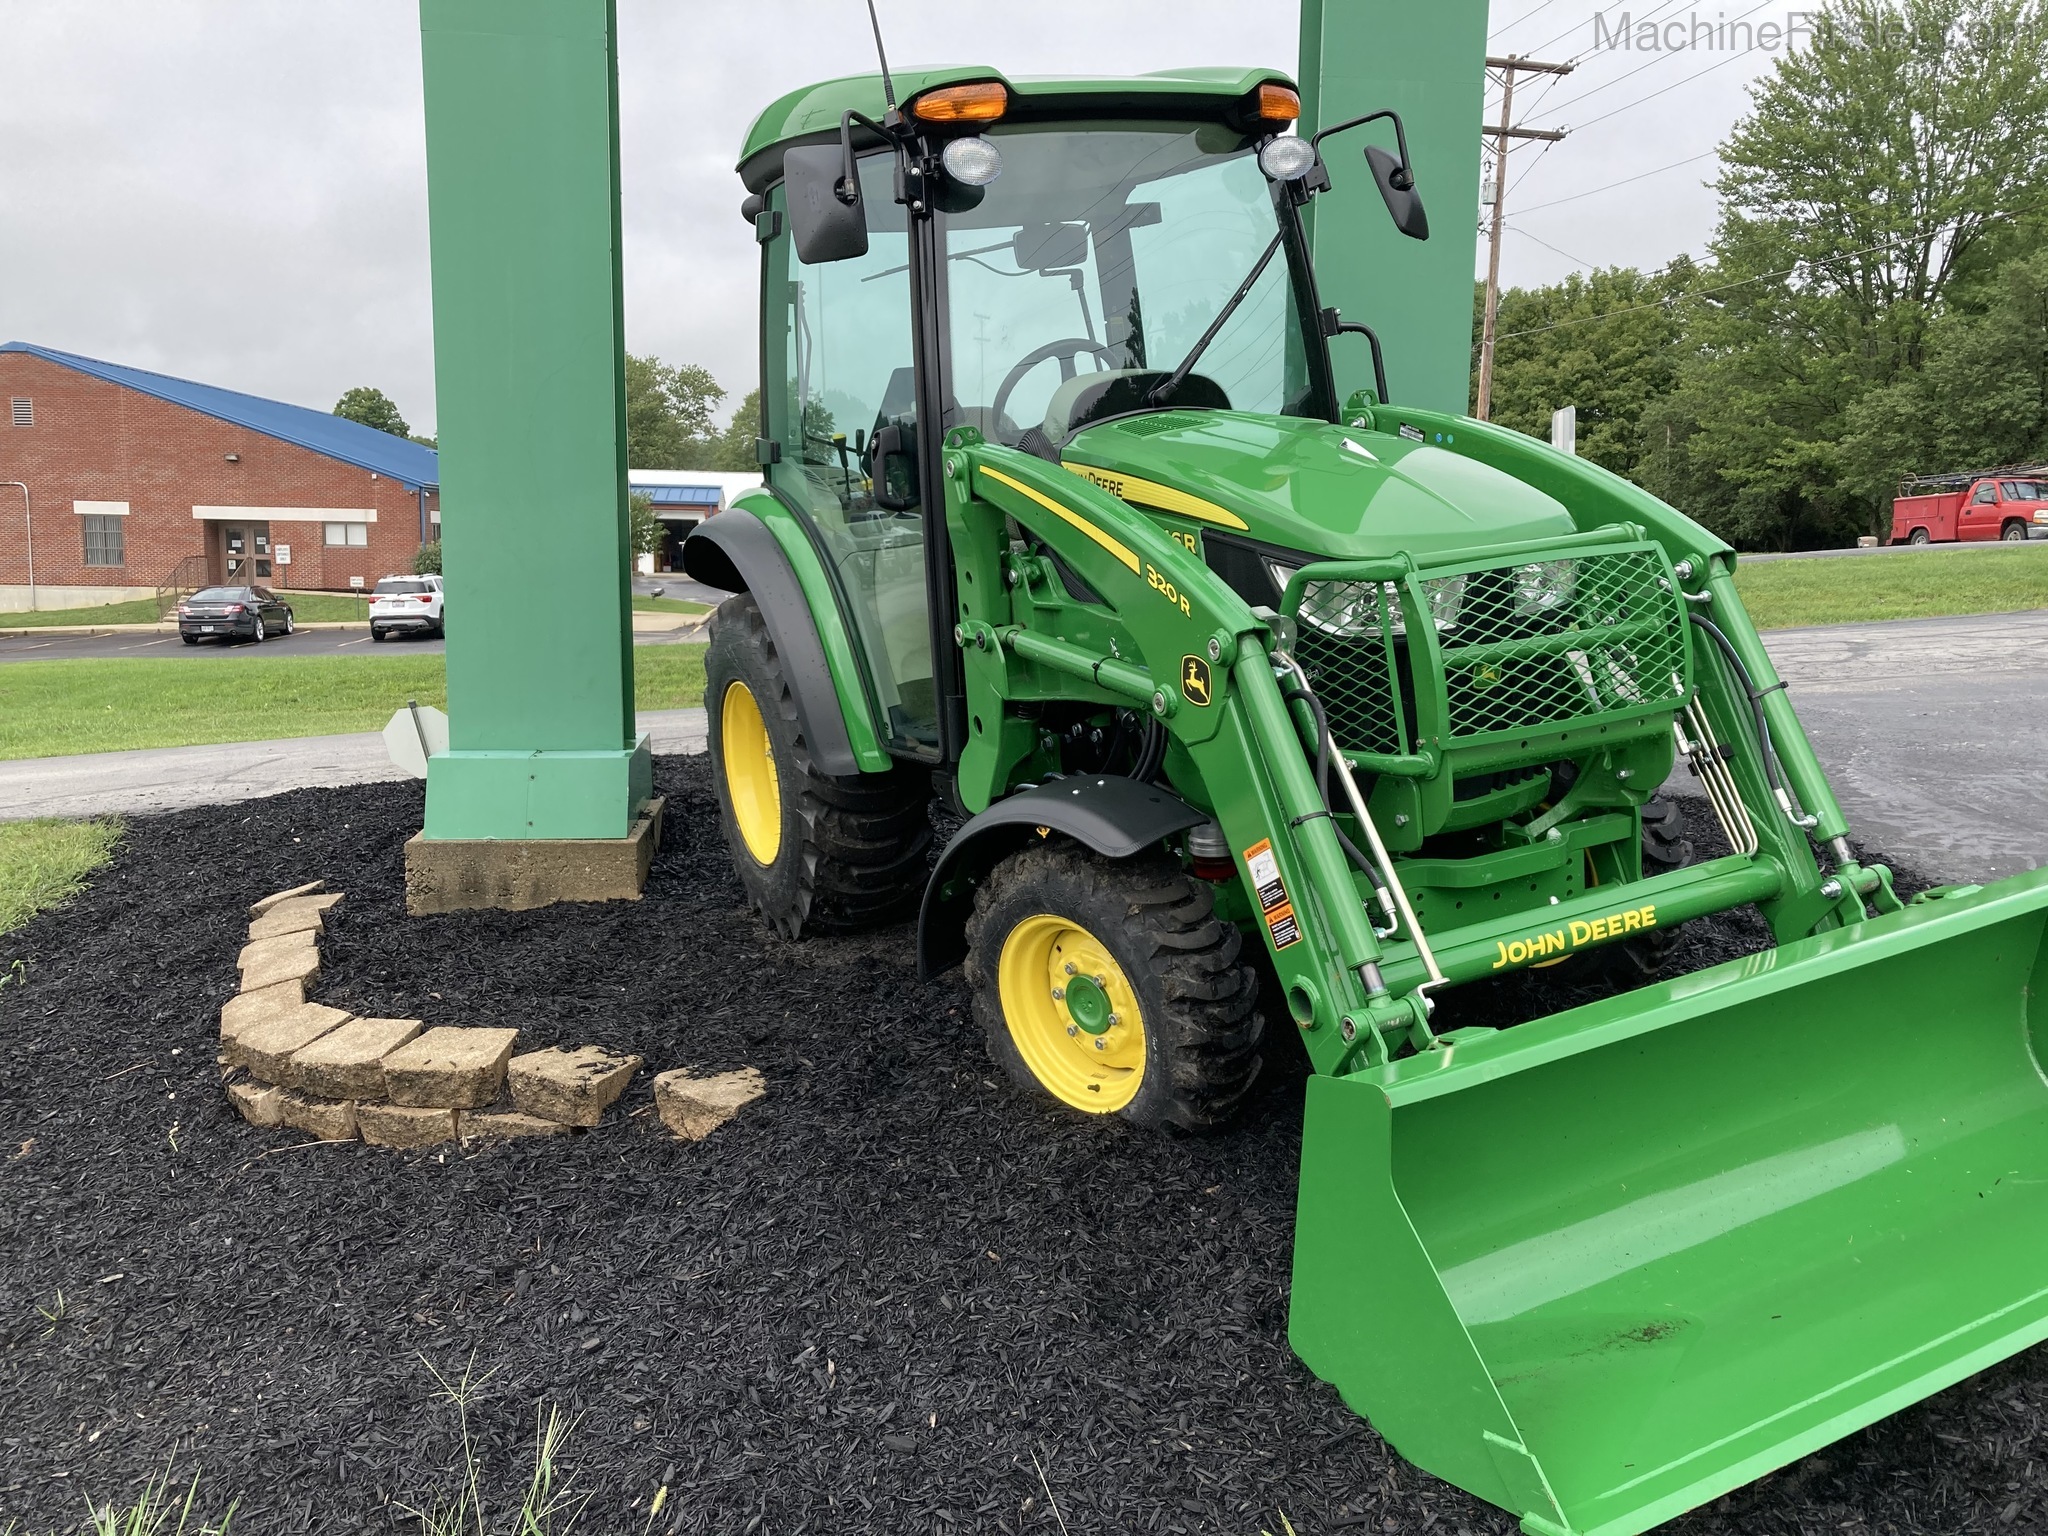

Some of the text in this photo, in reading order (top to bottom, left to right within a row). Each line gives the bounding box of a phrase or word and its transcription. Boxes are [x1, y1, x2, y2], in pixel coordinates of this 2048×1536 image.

[1146, 563, 1192, 620] 320 R
[1493, 905, 1657, 969] JOHN DEERE
